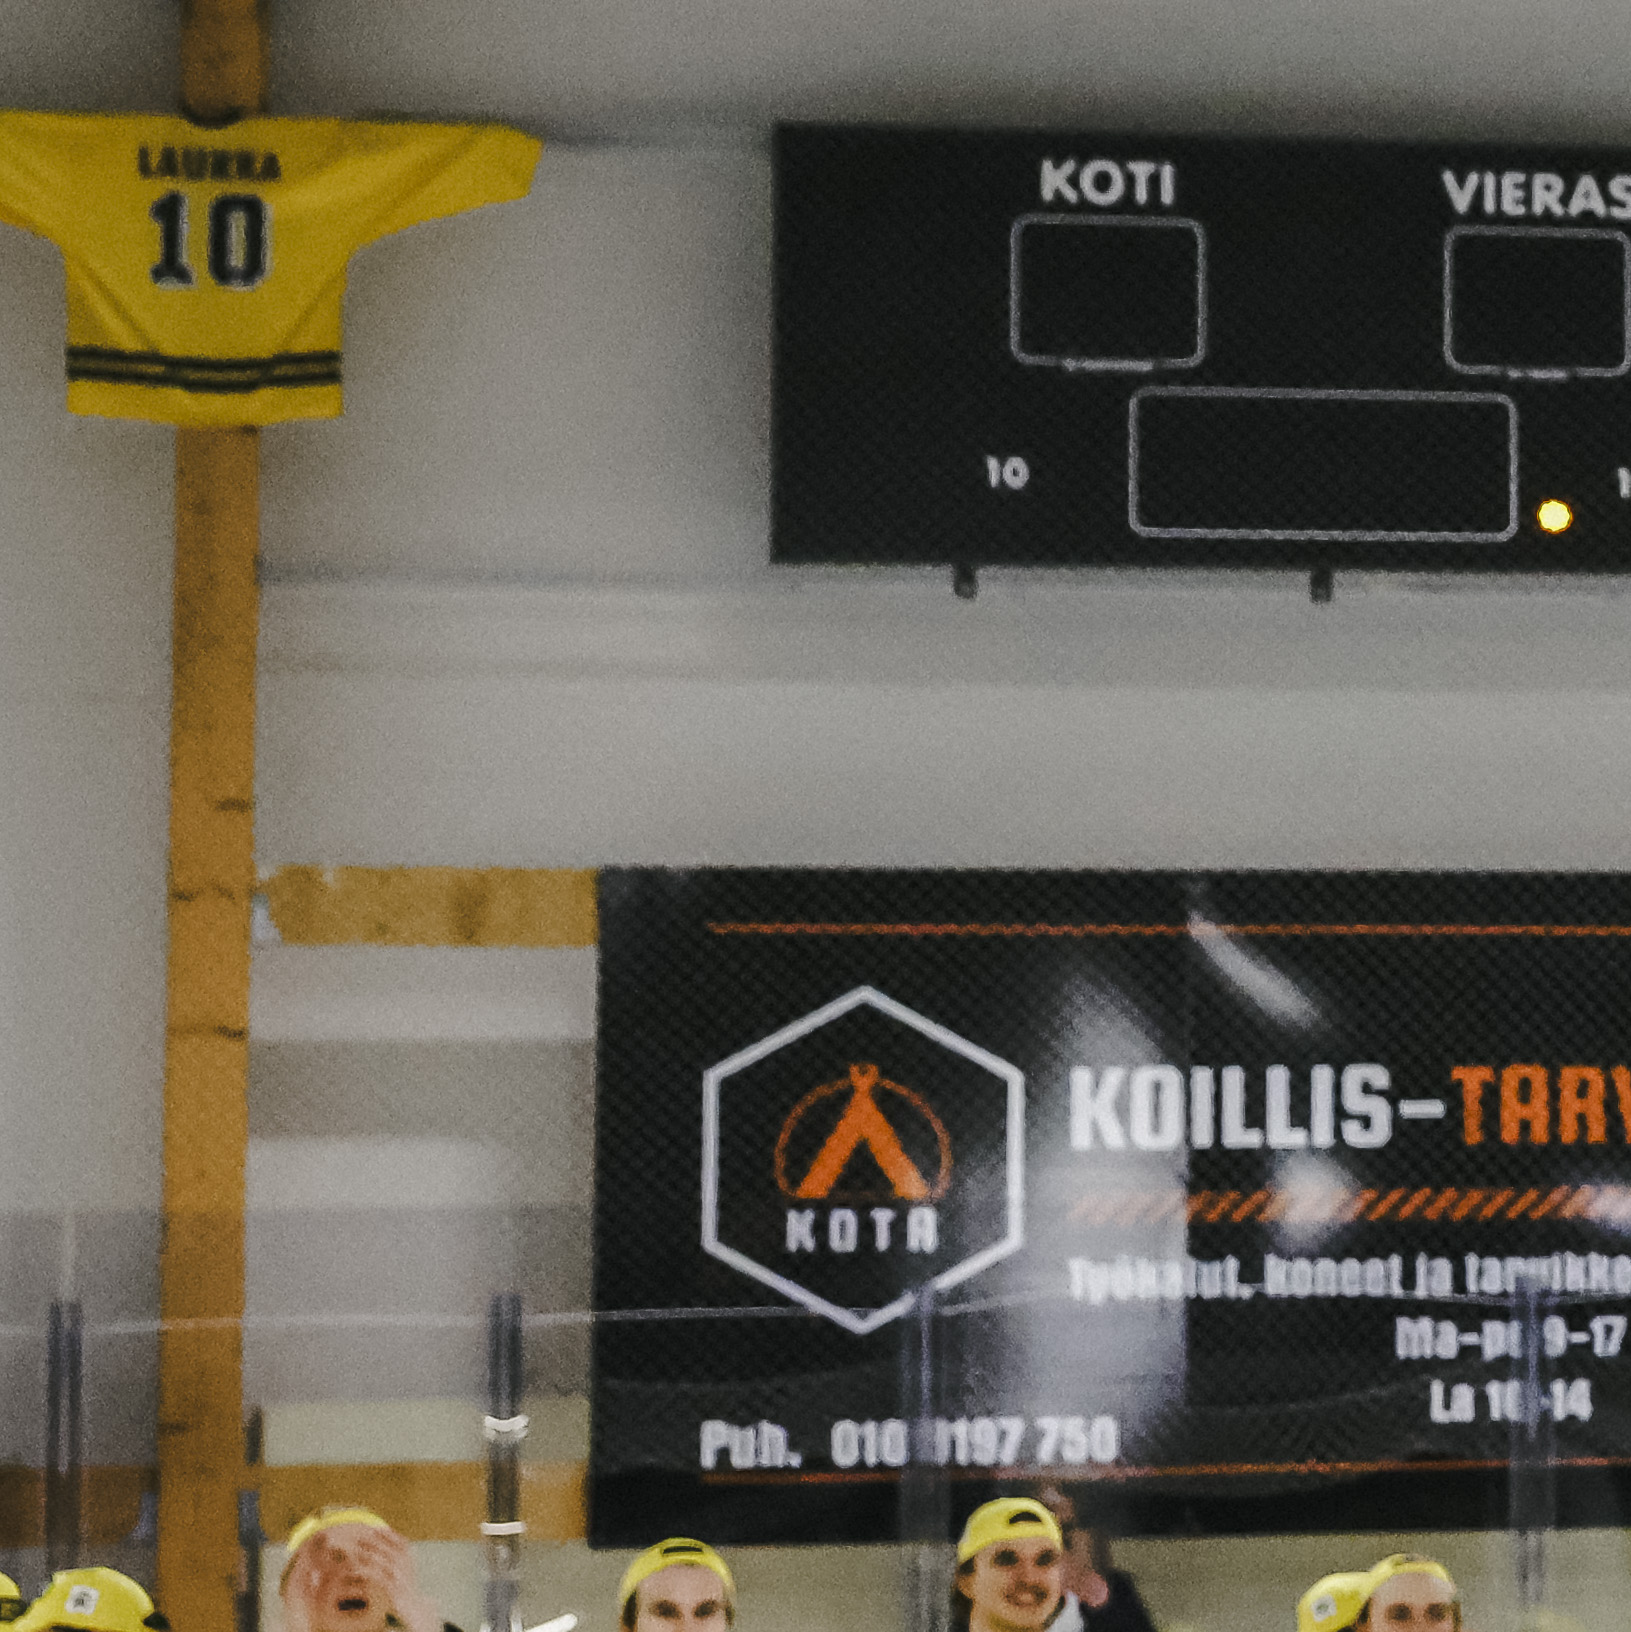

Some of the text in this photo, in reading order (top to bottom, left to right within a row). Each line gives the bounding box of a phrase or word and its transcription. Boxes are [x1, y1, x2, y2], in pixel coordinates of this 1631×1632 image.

[1039, 158, 1176, 206] KOTI
[149, 189, 275, 291] 10
[986, 455, 1031, 492] 10
[785, 1207, 938, 1254] KOTA
[700, 1419, 803, 1468] Puh.
[1036, 1415, 1119, 1464] 750
